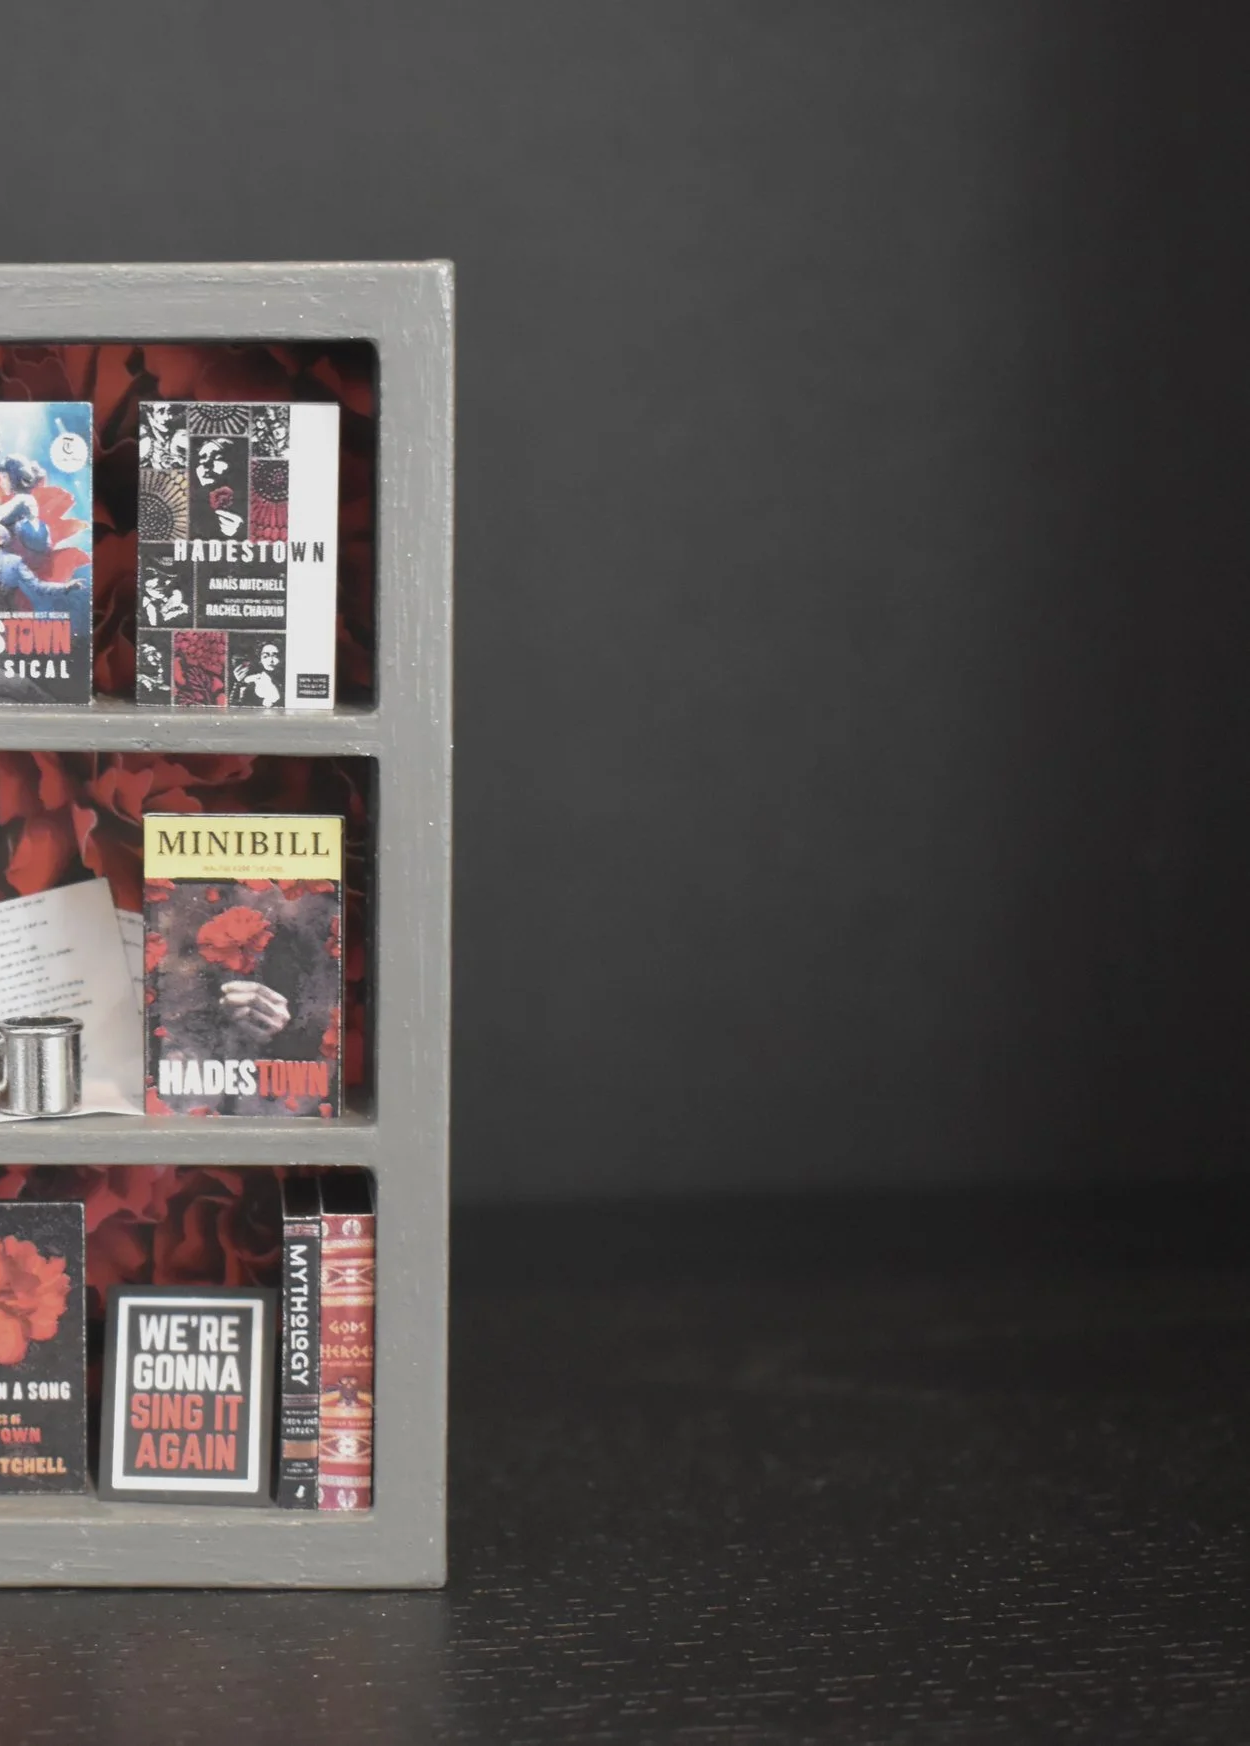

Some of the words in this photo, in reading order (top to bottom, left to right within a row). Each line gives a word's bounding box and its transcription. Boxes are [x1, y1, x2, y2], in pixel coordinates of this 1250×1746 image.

[173, 538, 325, 563] HADESTOWN
[239, 578, 285, 591] MITCHELL
[205, 603, 242, 616] RACHEL
[157, 830, 330, 856] MINIBILL
[158, 1059, 329, 1098] HADESTOWN
[289, 1244, 310, 1386] MYTHOLOGY
[328, 1319, 368, 1335] GODS
[138, 1313, 241, 1352] WE'RE
[133, 1353, 243, 1392] GONNA
[12, 1381, 24, 1400] A
[27, 1381, 71, 1400] SONG
[130, 1393, 204, 1431] SING
[214, 1394, 244, 1432] IT
[134, 1432, 237, 1471] AGAIN
